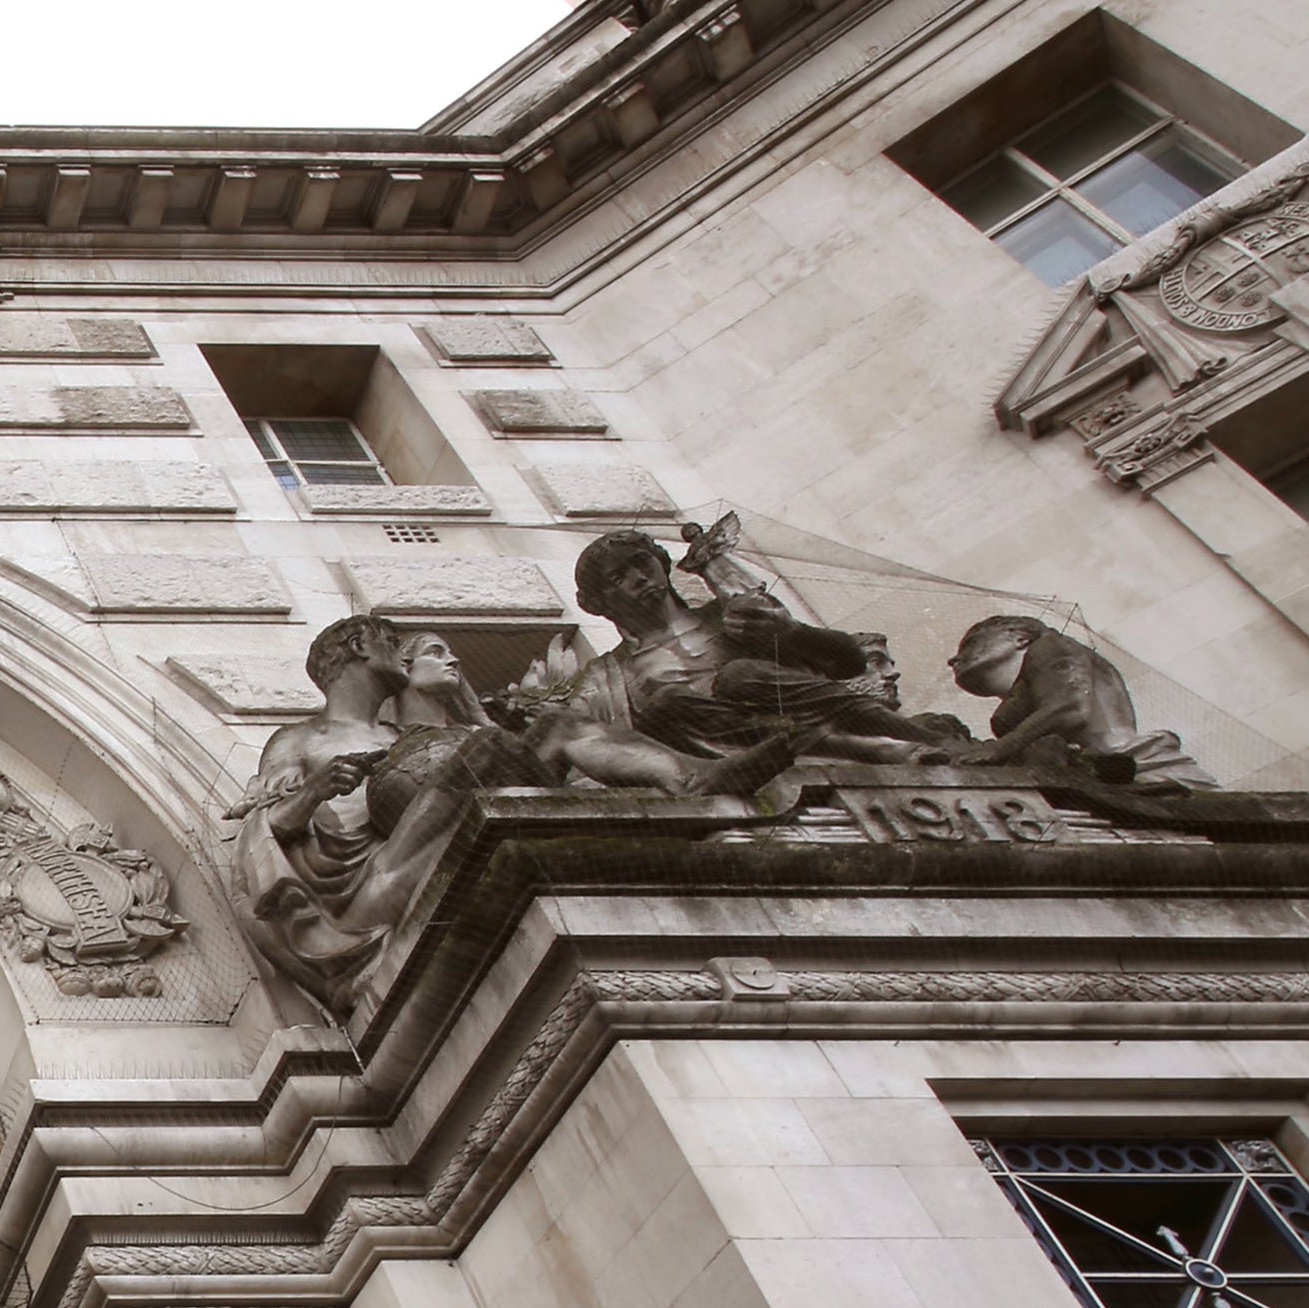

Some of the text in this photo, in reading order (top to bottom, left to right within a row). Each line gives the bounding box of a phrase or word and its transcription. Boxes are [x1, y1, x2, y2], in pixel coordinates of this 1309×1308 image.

[1182, 305, 1196, 318] &
[1194, 306, 1271, 329] LONDON
[864, 797, 1060, 844] 1918
[24, 839, 119, 943] NORTH SEA
